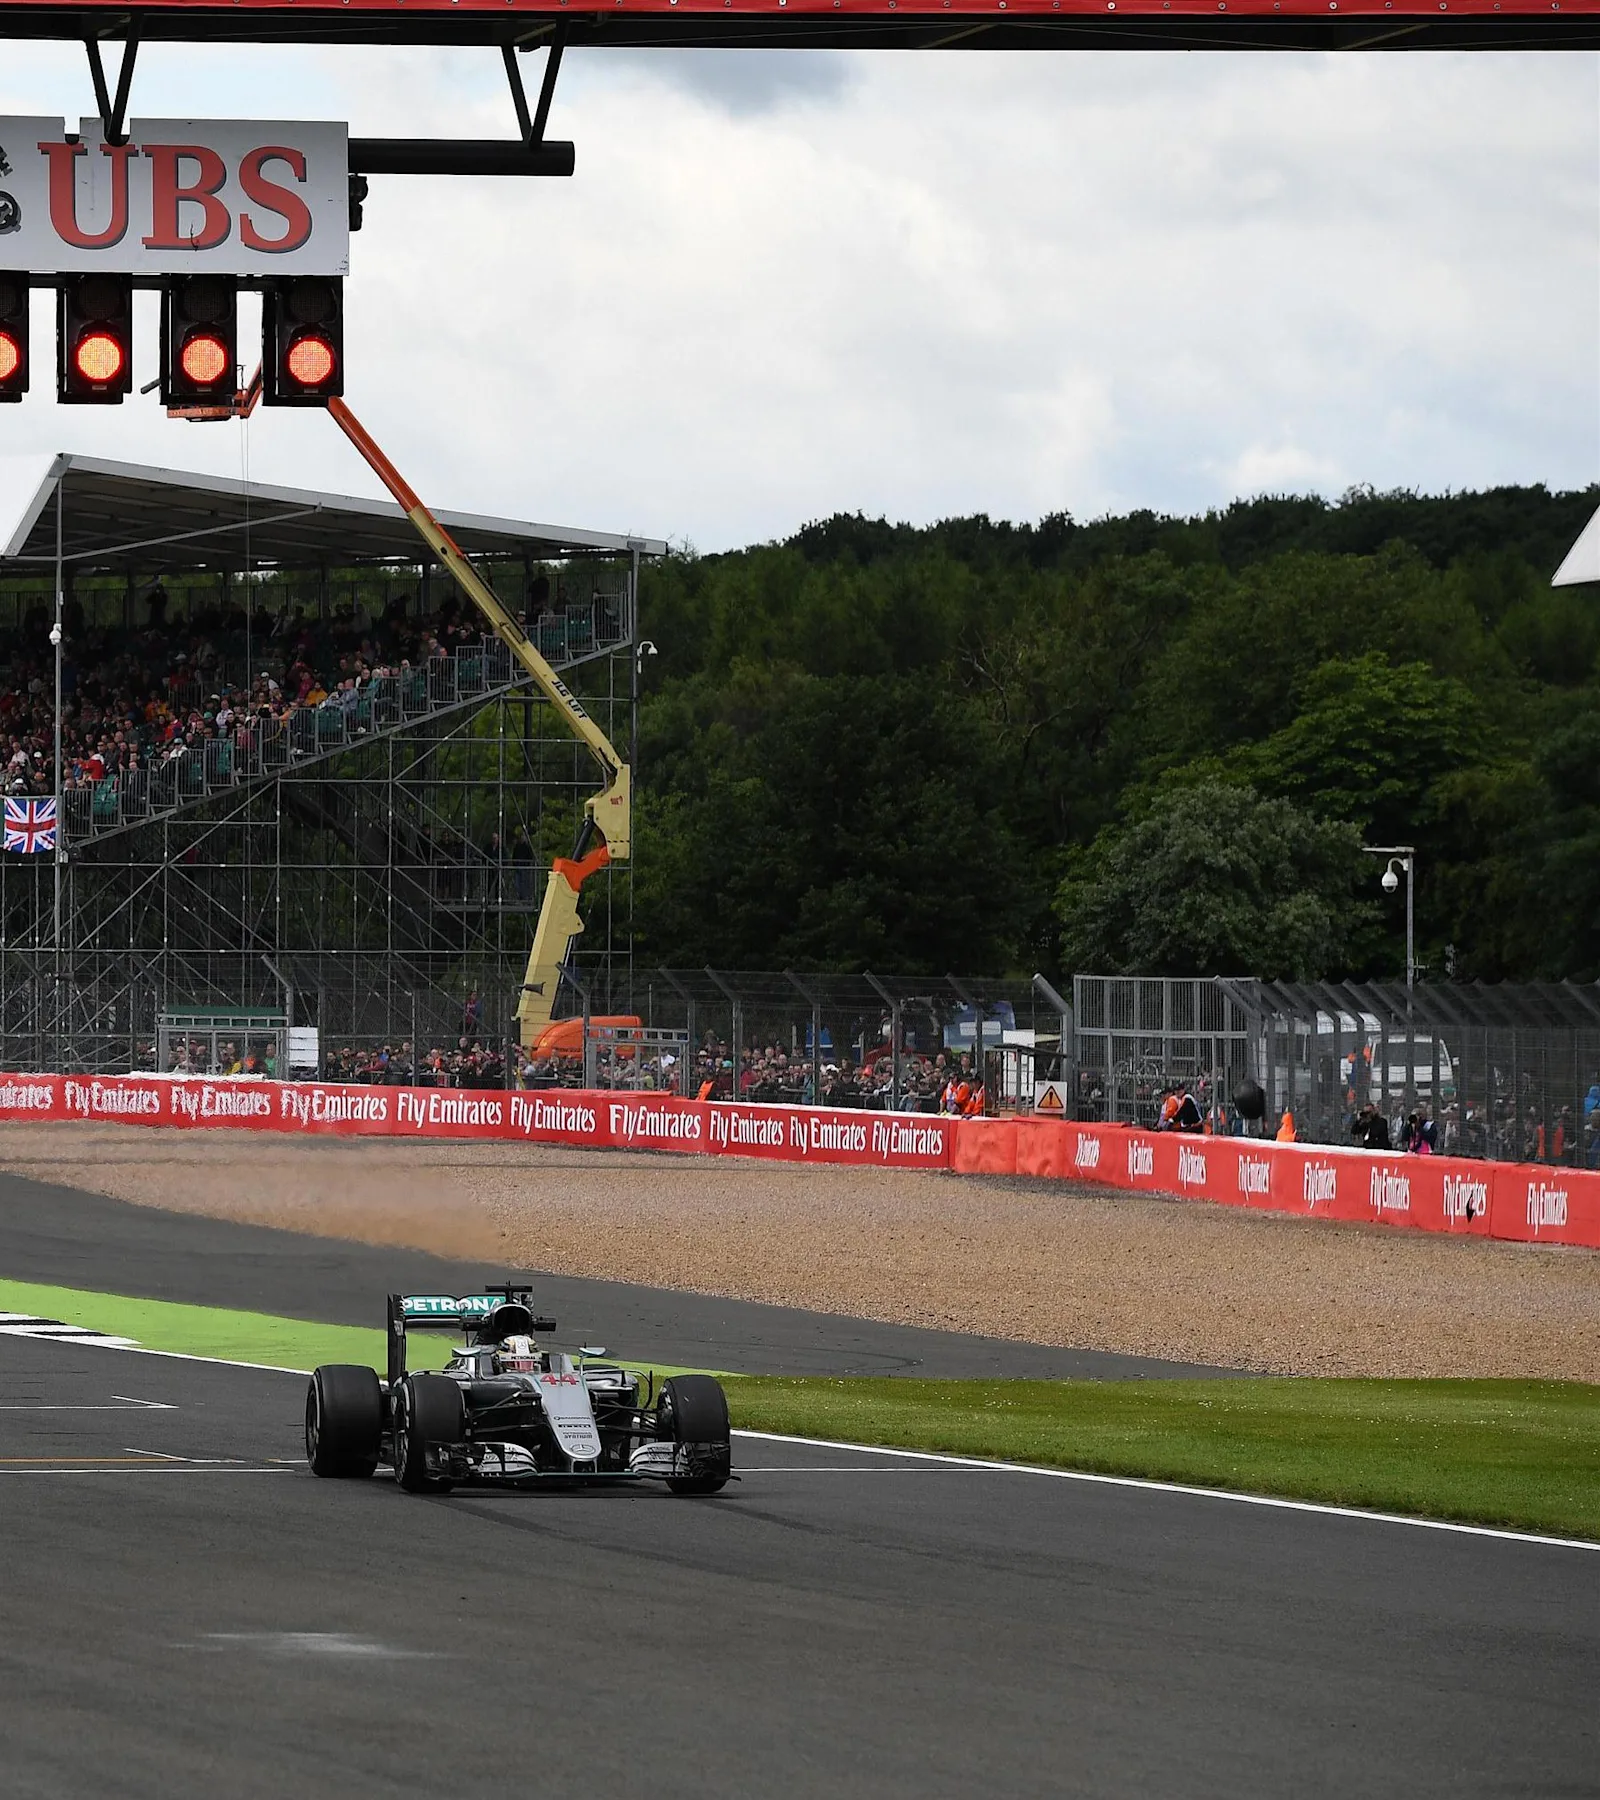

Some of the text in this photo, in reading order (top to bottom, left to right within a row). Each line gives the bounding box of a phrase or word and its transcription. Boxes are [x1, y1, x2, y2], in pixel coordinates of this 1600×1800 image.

[37, 142, 312, 253] UBS
[552, 680, 569, 697] JLG
[65, 1080, 160, 1116] Fly Emirates
[170, 1084, 271, 1121] Fly Emirates
[281, 1088, 388, 1127] Fly Emirates
[397, 1091, 502, 1129] Fly Emirates
[510, 1096, 596, 1135] Fly Emirates
[609, 1103, 702, 1142] Fly Emirates
[709, 1110, 784, 1149] Fly Emirates
[790, 1115, 867, 1155] Fly Emirates
[871, 1120, 944, 1160] Fly Emirates
[1370, 1166, 1382, 1216] Fly
[1443, 1174, 1455, 1226] Fly
[1527, 1182, 1540, 1236] Fly
[400, 1298, 502, 1312] PETRONA
[541, 1374, 579, 1386] 44
